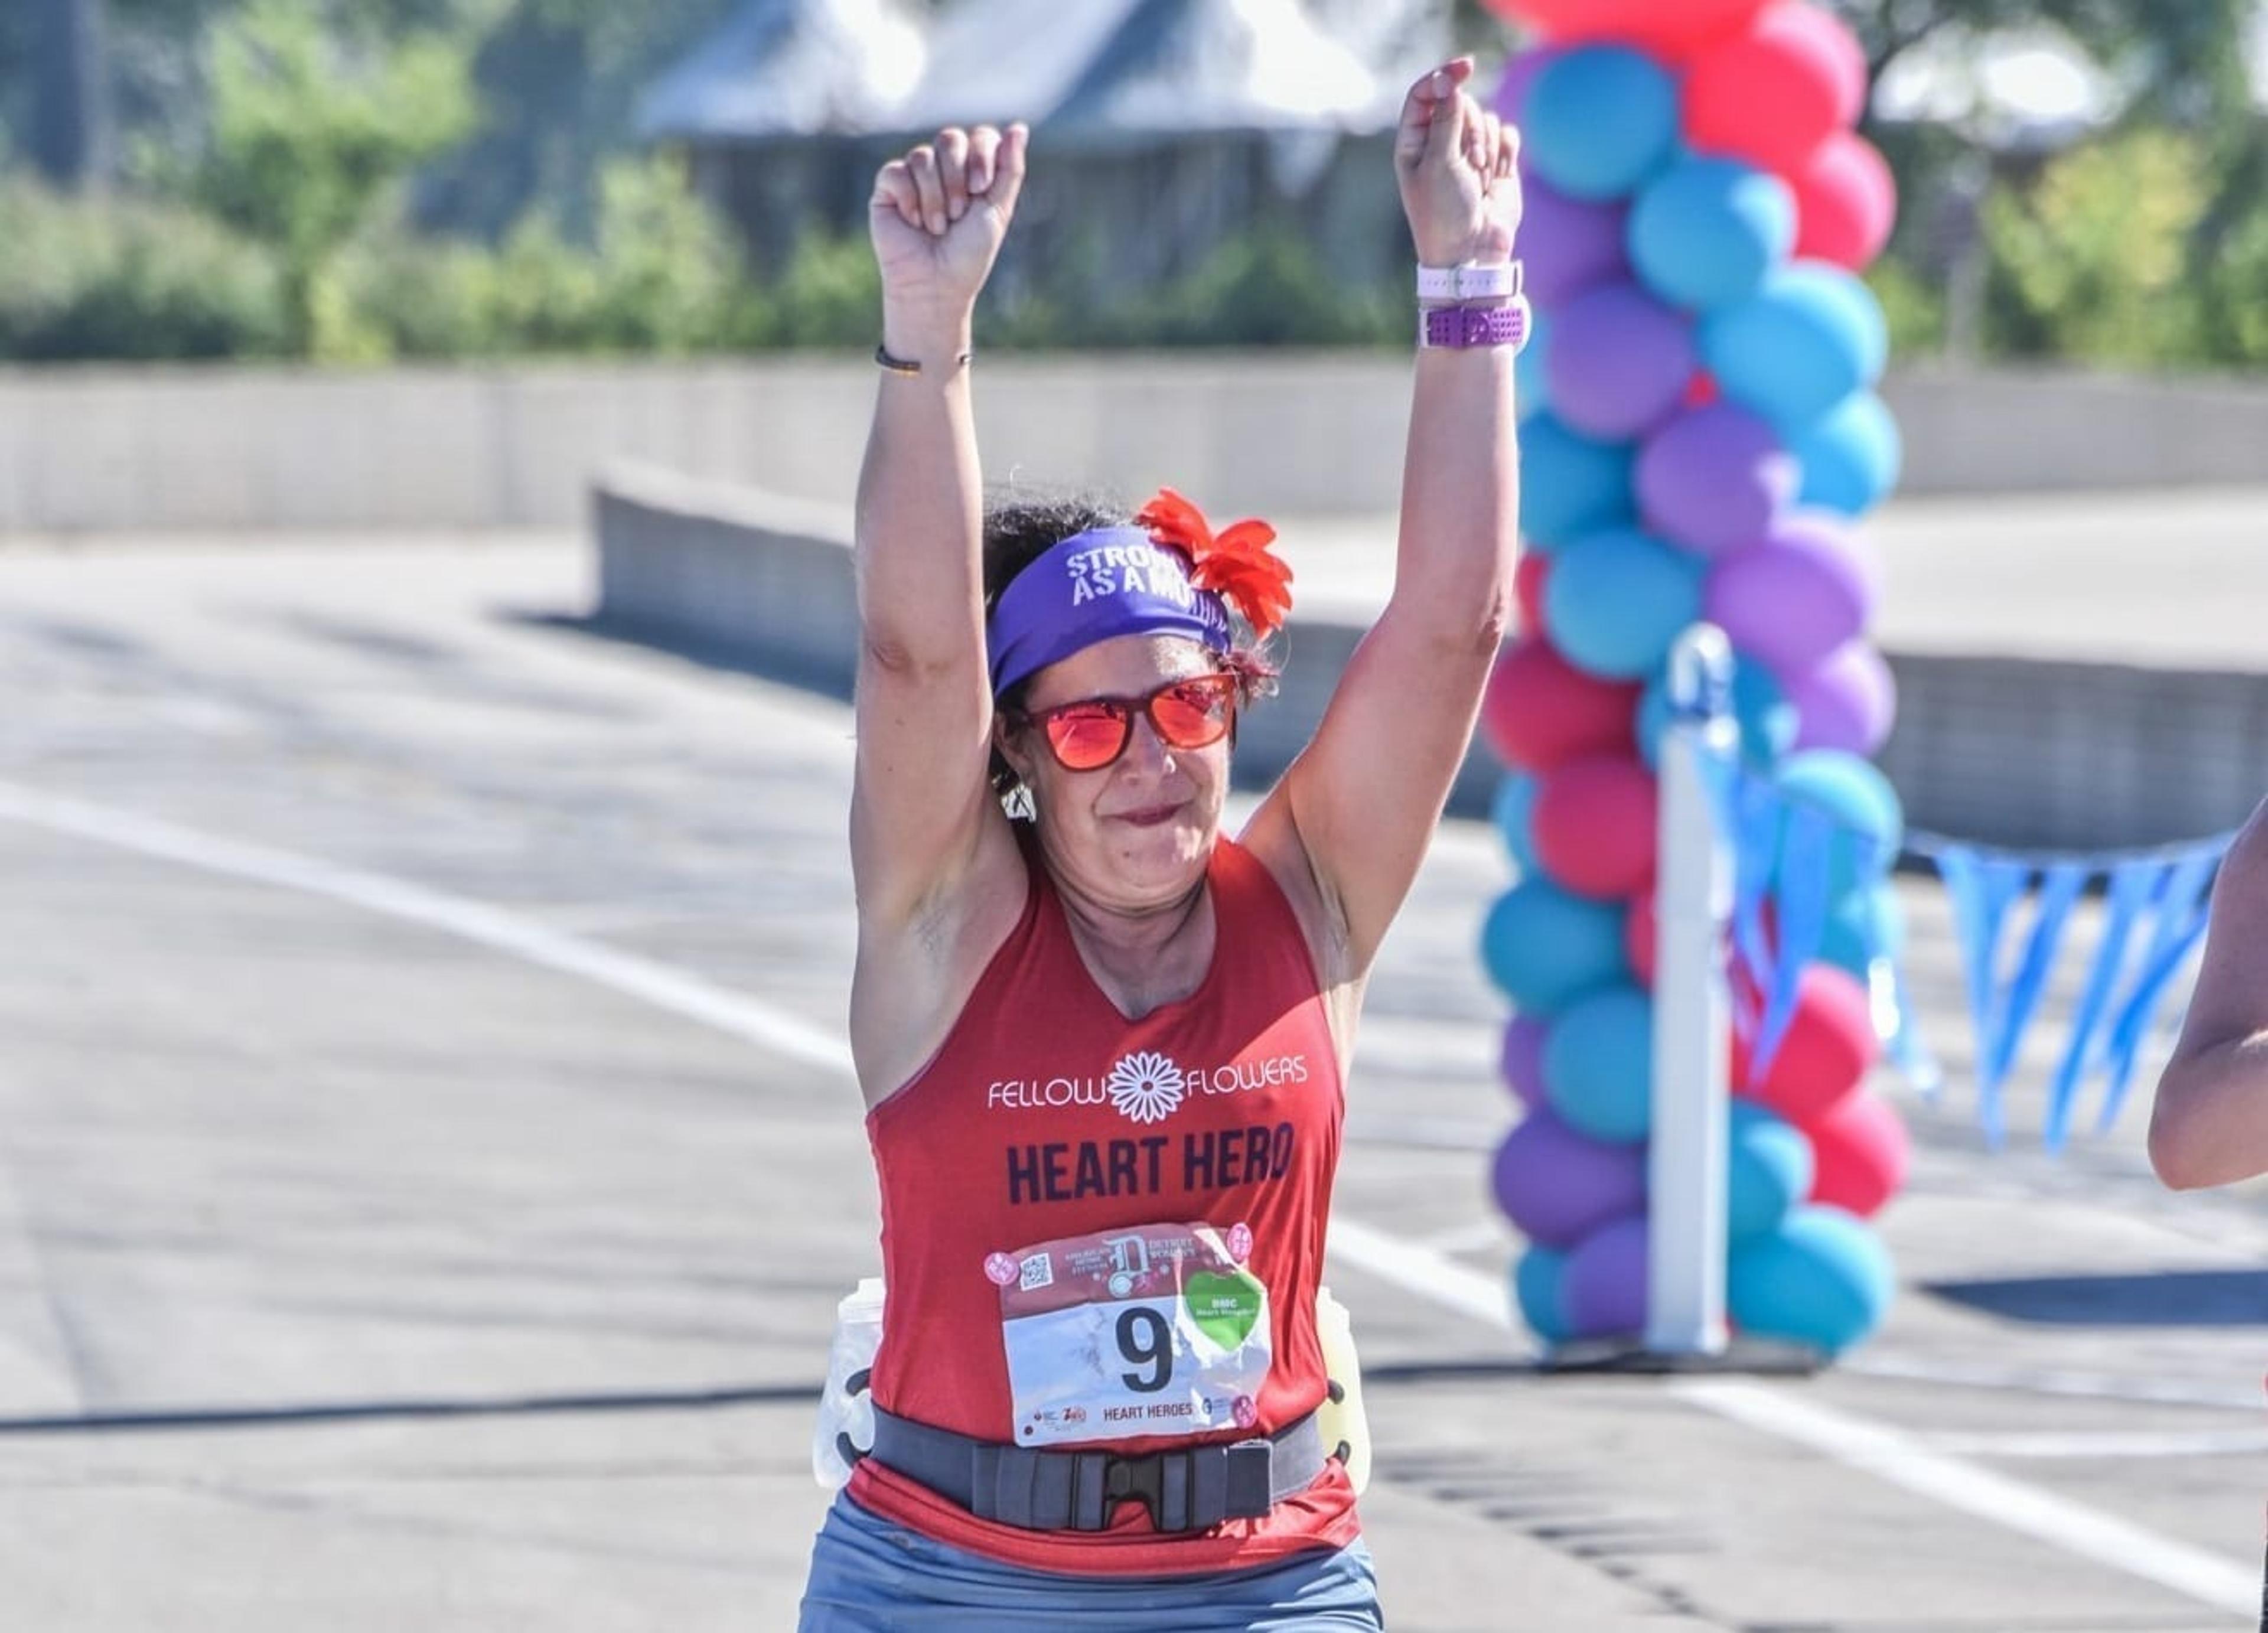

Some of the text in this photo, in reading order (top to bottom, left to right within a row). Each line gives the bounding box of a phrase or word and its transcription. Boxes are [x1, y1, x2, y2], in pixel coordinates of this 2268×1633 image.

[1073, 569, 1116, 607] AS
[1123, 566, 1145, 594] A
[988, 1055, 1308, 1109] FELLOW FLOWERS
[1007, 1121, 1295, 1205] HEART HERO
[1116, 1306, 1173, 1393] 9
[1103, 1405, 1143, 1422] HEART
[1148, 1402, 1192, 1418] HEROES
